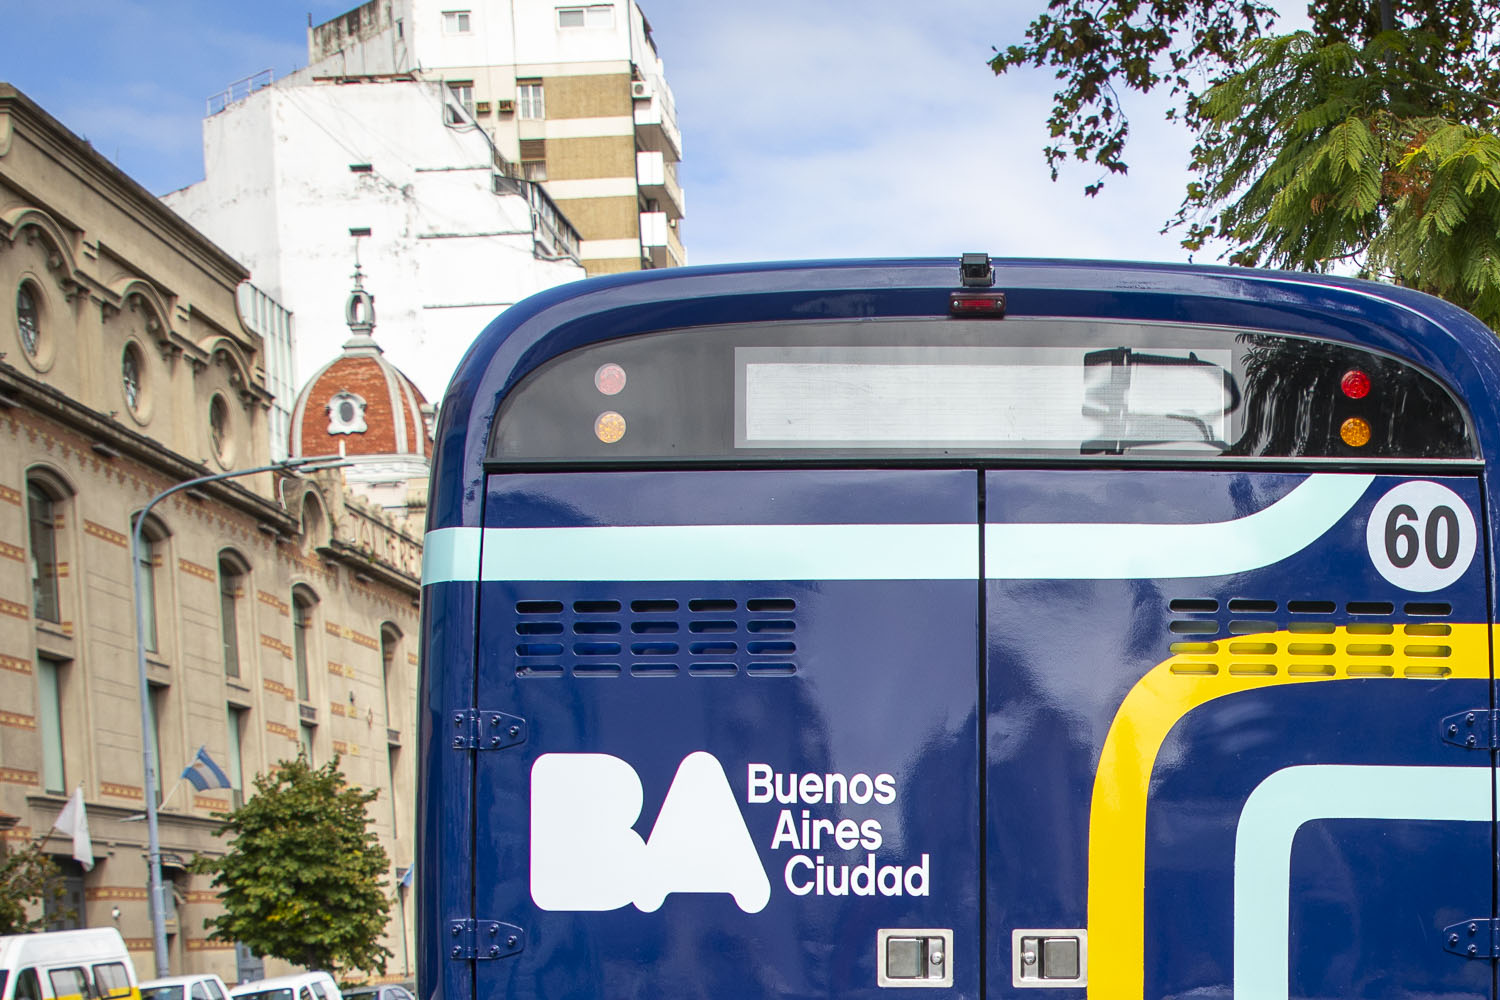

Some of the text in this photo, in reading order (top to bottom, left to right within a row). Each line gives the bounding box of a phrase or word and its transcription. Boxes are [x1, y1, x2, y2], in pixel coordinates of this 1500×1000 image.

[1385, 505, 1459, 568] 60
[748, 763, 896, 805] Buenos
[531, 751, 771, 912] BA
[771, 809, 882, 851] Aires
[785, 853, 929, 897] Ciudad
